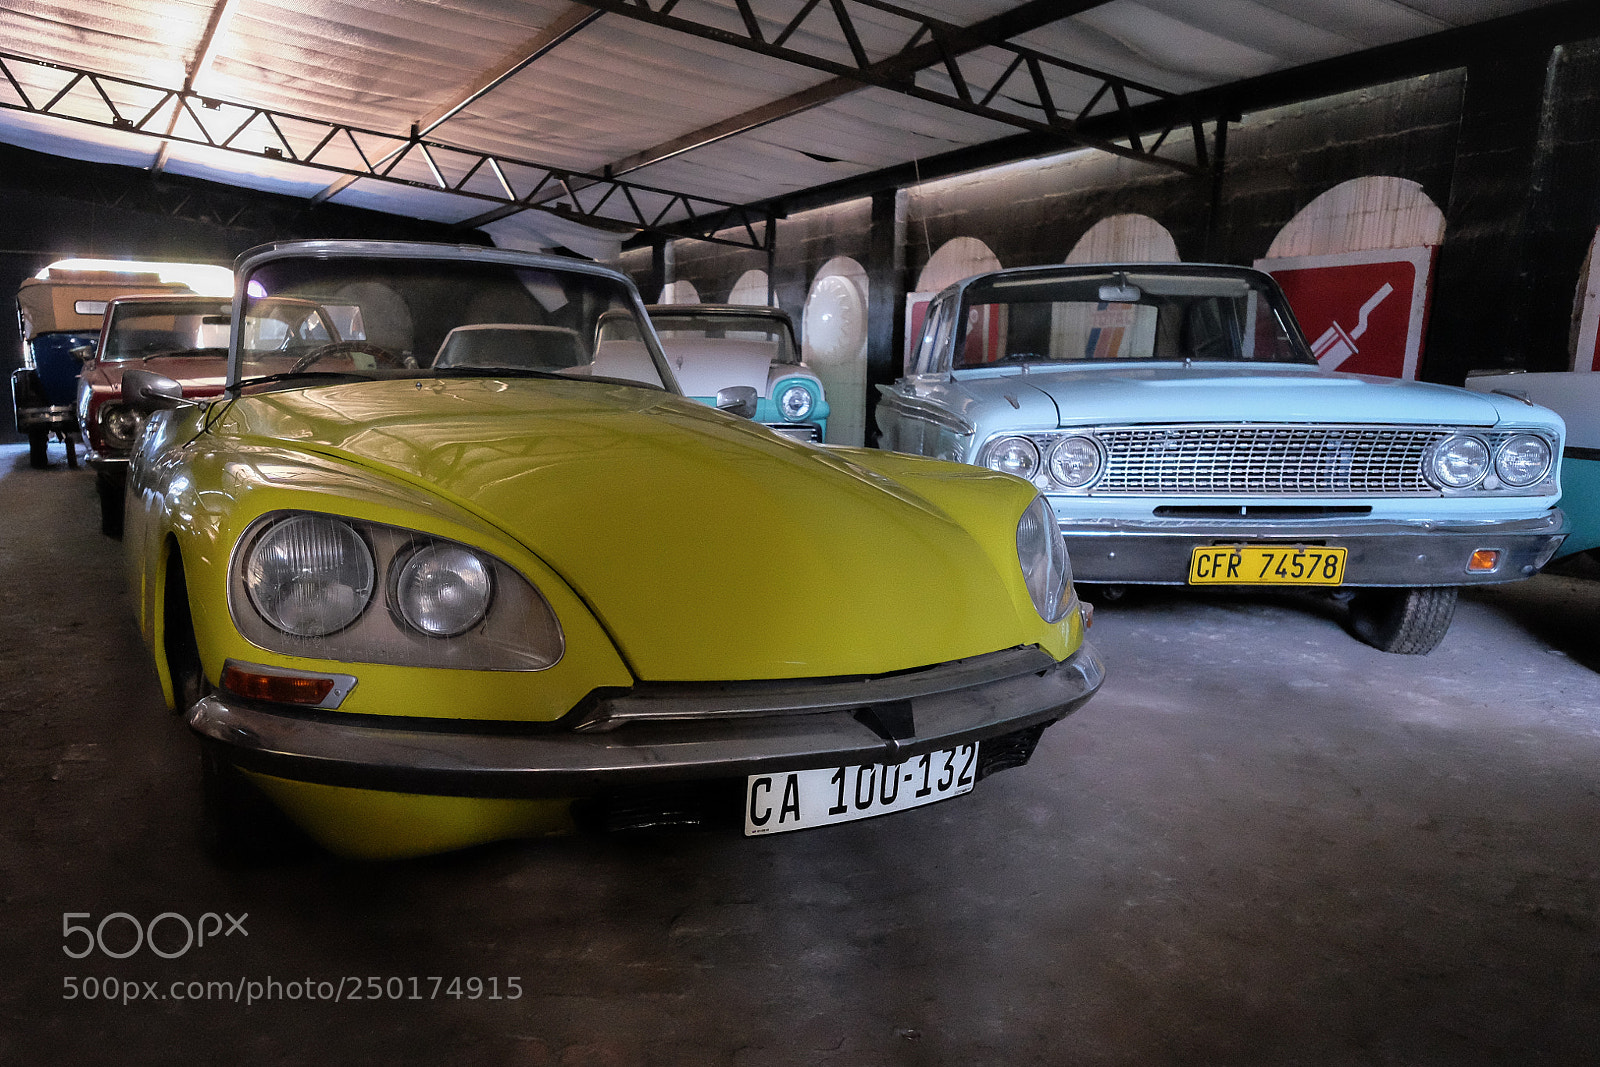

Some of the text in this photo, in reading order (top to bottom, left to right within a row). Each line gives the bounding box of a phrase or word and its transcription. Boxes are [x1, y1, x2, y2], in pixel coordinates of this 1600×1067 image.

[1196, 553, 1339, 579] CFR 74578
[750, 742, 976, 827] CA 100-132
